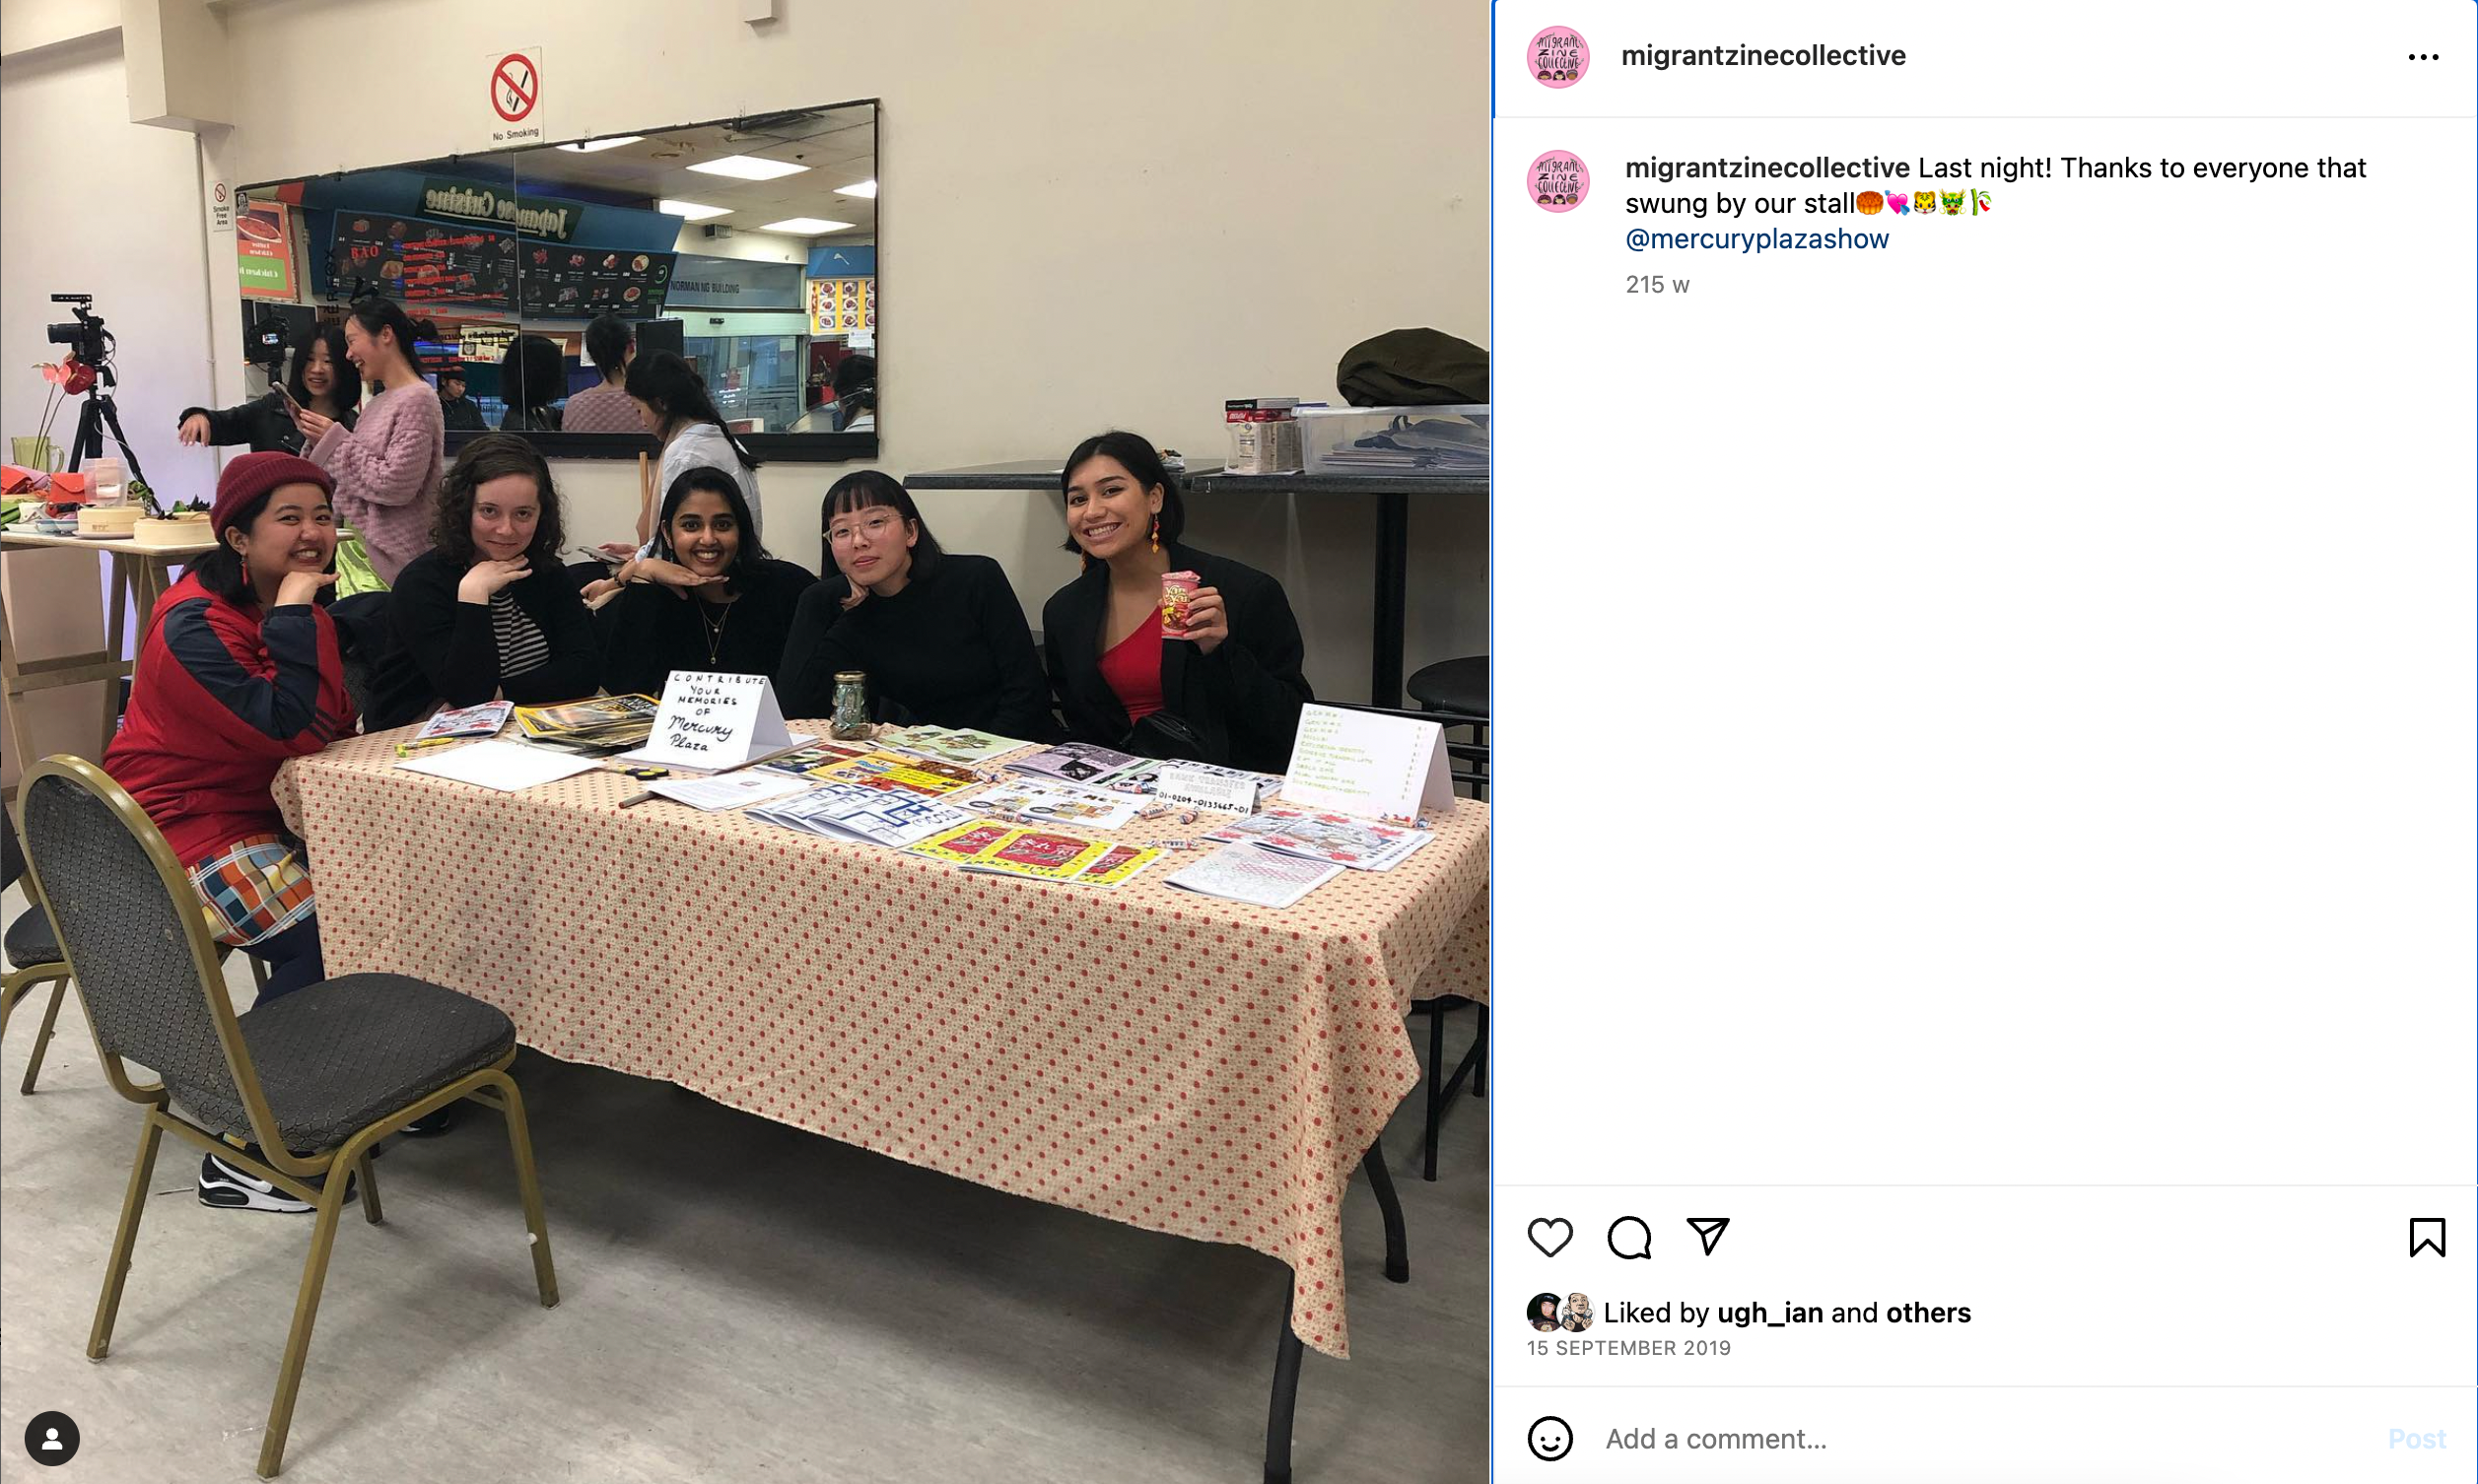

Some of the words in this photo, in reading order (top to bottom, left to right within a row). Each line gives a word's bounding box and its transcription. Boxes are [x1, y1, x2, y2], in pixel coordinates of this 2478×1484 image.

[493, 132, 504, 141] No
[507, 127, 539, 139] Smoking
[350, 245, 380, 259] BAO
[670, 280, 700, 293] NORMAN
[712, 283, 740, 295] BUILDING
[674, 673, 766, 685] CONTRIBUTE
[690, 685, 721, 696] YOUR
[678, 697, 737, 706] MEMORIES
[696, 708, 711, 716] OF
[668, 715, 733, 743] Mercury
[669, 732, 709, 752] Plaza
